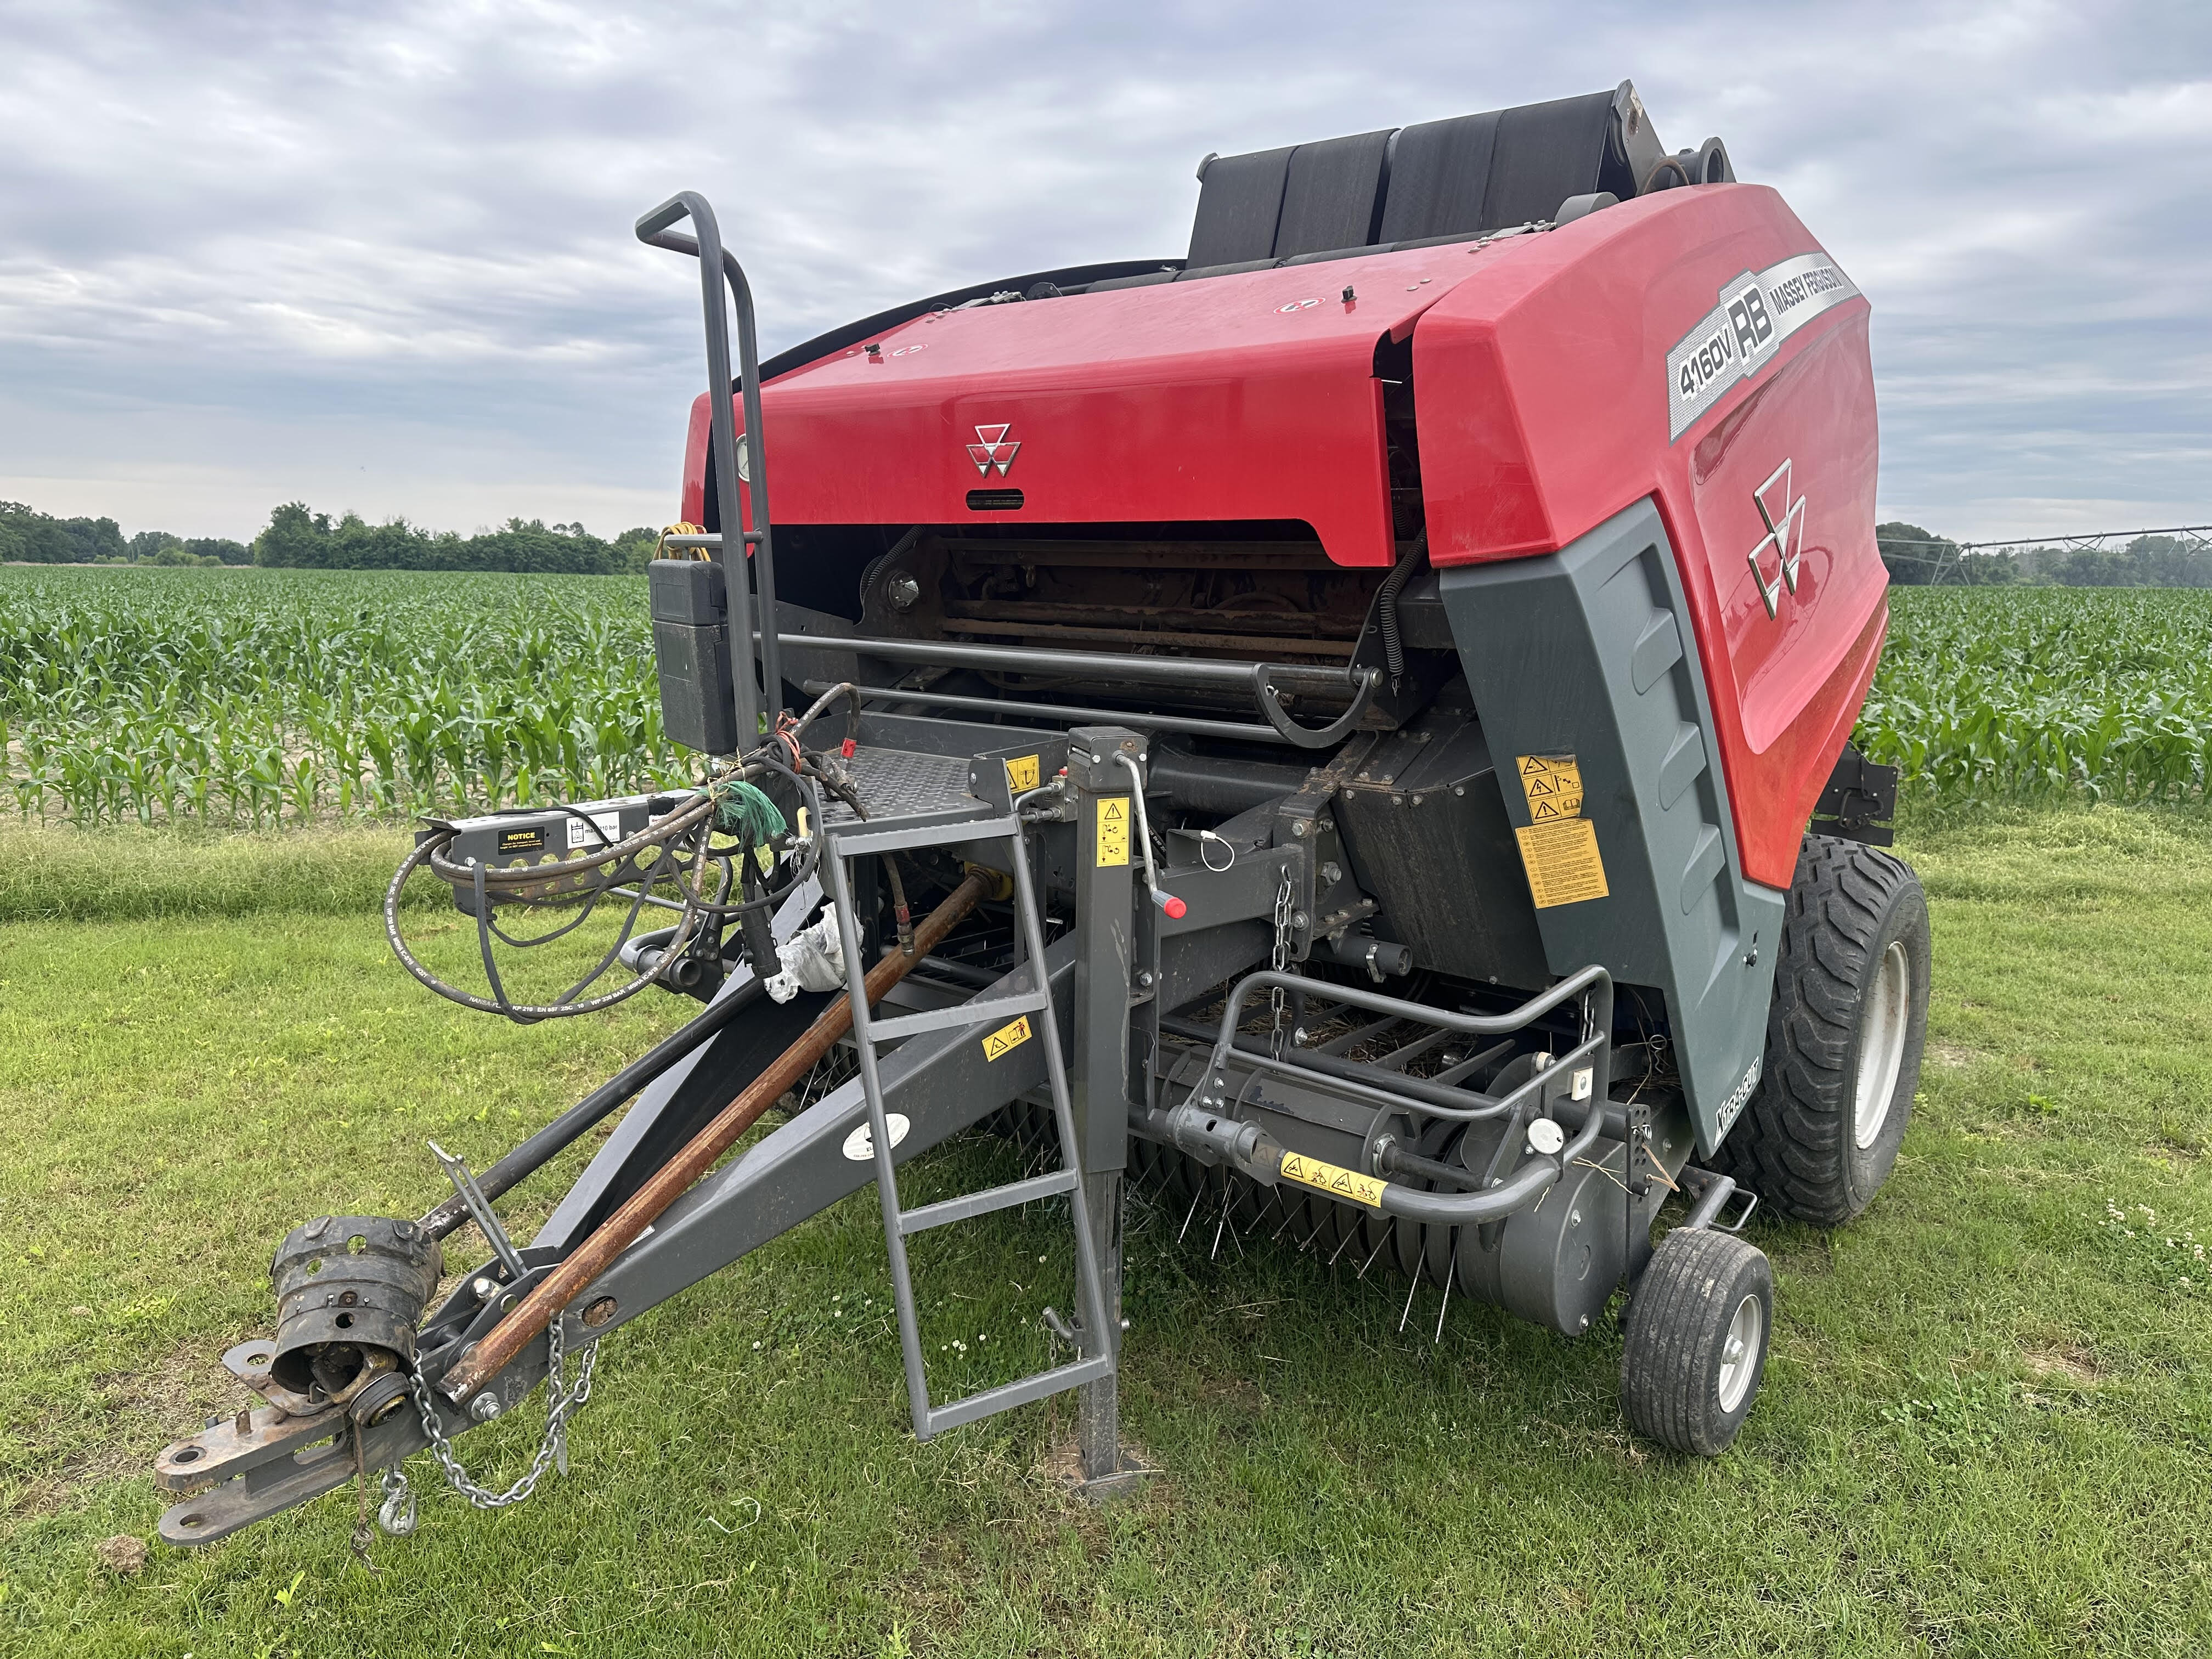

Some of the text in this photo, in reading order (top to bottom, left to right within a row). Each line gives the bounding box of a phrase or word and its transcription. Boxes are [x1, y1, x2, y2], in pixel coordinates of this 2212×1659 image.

[1769, 267, 1842, 315] MASSEY FERGUSON
[1681, 287, 1773, 395] 4160V RB
[507, 832, 535, 840] NOTICE
[613, 989, 626, 998] BAR
[627, 979, 644, 991] MSHA
[1714, 1056, 1759, 1147] XTRA-CUT
